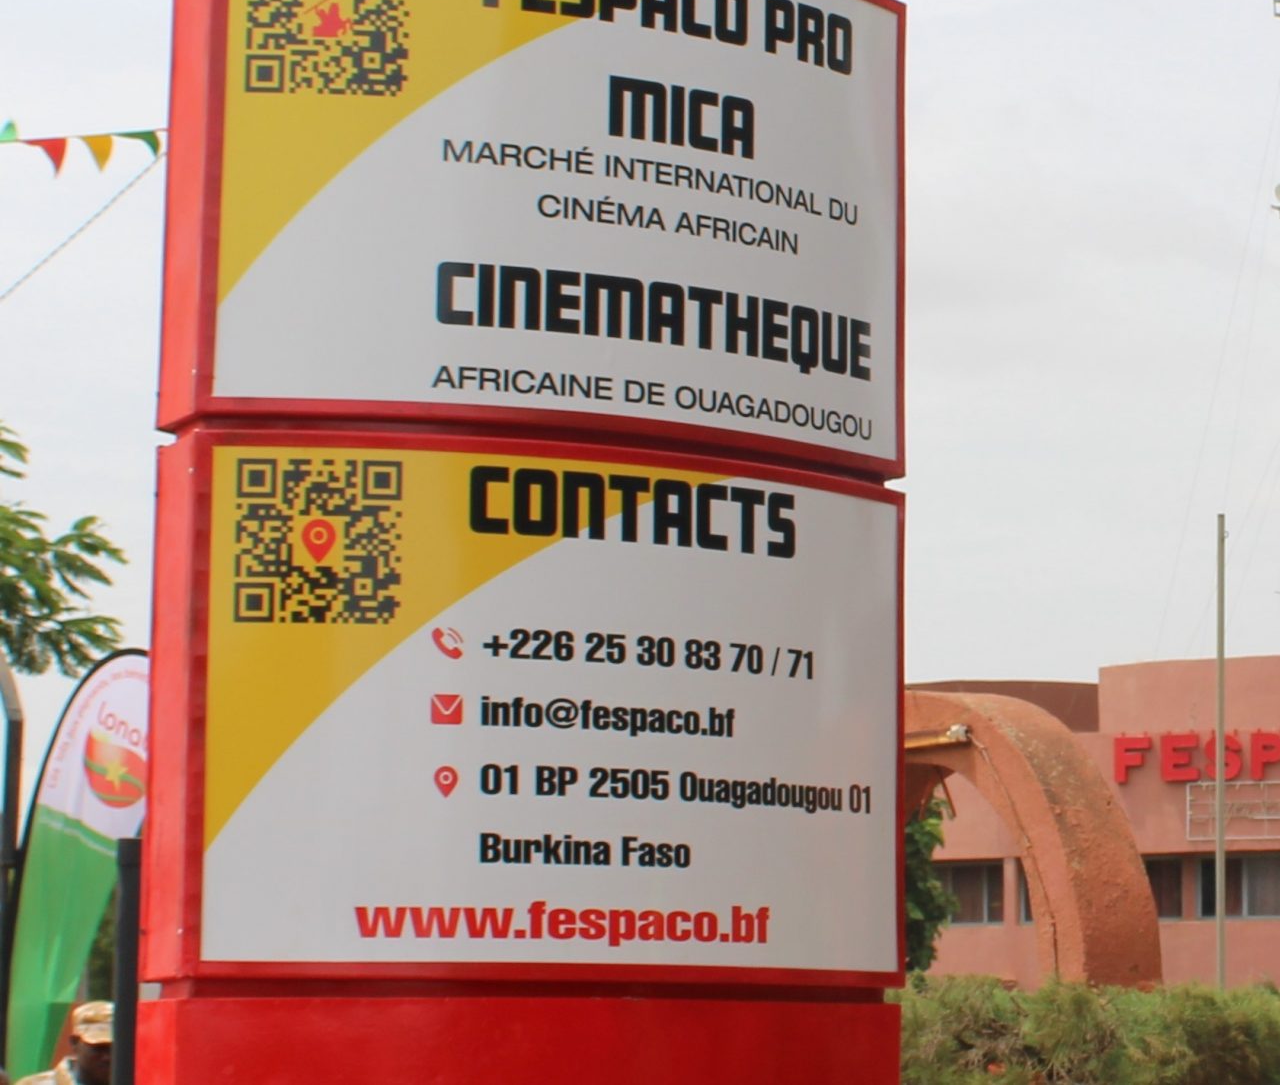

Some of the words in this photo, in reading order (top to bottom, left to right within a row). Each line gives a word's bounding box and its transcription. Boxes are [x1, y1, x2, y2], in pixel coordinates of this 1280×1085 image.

[609, 75, 755, 160] MICA
[442, 138, 594, 176] MARCHÉ
[604, 156, 822, 217] INTERNATIONAL
[828, 196, 859, 226] DU
[537, 193, 663, 230] CINÉMA
[674, 212, 798, 255] AFRICAIN
[436, 261, 872, 381] CINEMATHEQUE
[432, 365, 612, 401] AFRICAINE
[625, 380, 665, 406] DE
[675, 385, 872, 441] OUAGADOUGOU
[470, 465, 796, 559] CONTACTS
[482, 628, 574, 662] +226
[585, 633, 626, 664] 25
[636, 636, 675, 667] 30
[685, 638, 721, 671] 83
[730, 643, 764, 675] 70
[770, 646, 780, 677] /
[787, 648, 814, 680] 71
[480, 696, 736, 738] info@fespaco.bf
[480, 764, 519, 796] 01
[535, 765, 577, 797] BP
[589, 768, 669, 800] 2505
[679, 771, 842, 813] Ouagadougou
[849, 784, 871, 815] 01
[479, 833, 611, 866] Burkina
[621, 837, 692, 869] Faso
[354, 901, 770, 947] www.fespaco.bf
